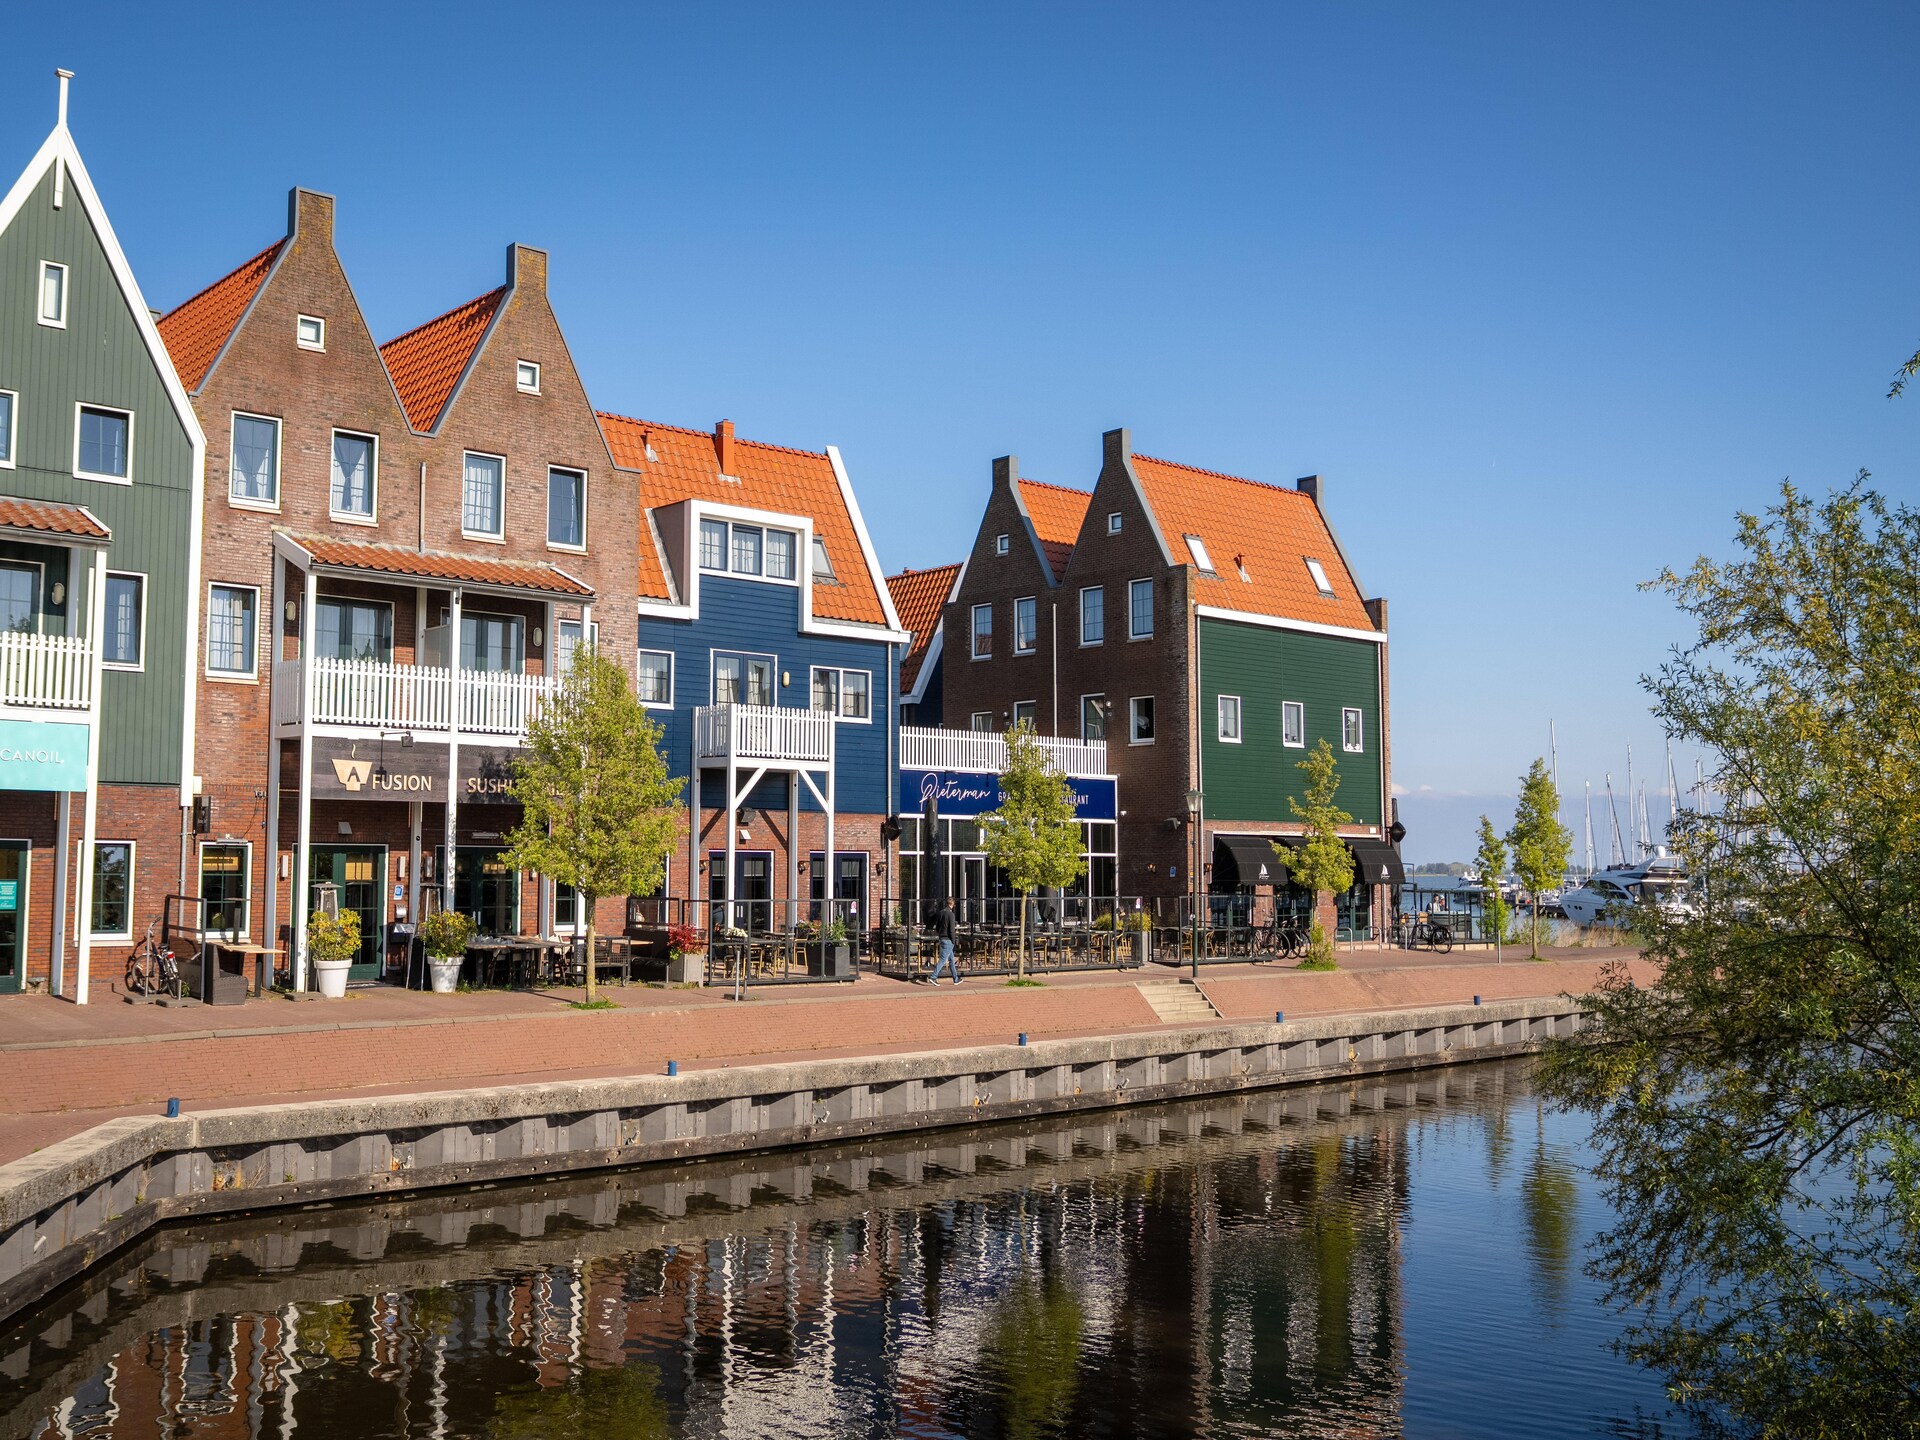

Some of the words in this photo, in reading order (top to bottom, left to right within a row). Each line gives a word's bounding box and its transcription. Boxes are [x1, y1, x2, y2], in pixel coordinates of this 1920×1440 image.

[0, 748, 64, 763] CANOIL
[347, 766, 361, 783] A
[373, 774, 432, 792] FUSION
[467, 777, 513, 793] SUSHI
[919, 772, 990, 811] Pieterman
[998, 791, 1014, 802] GRA
